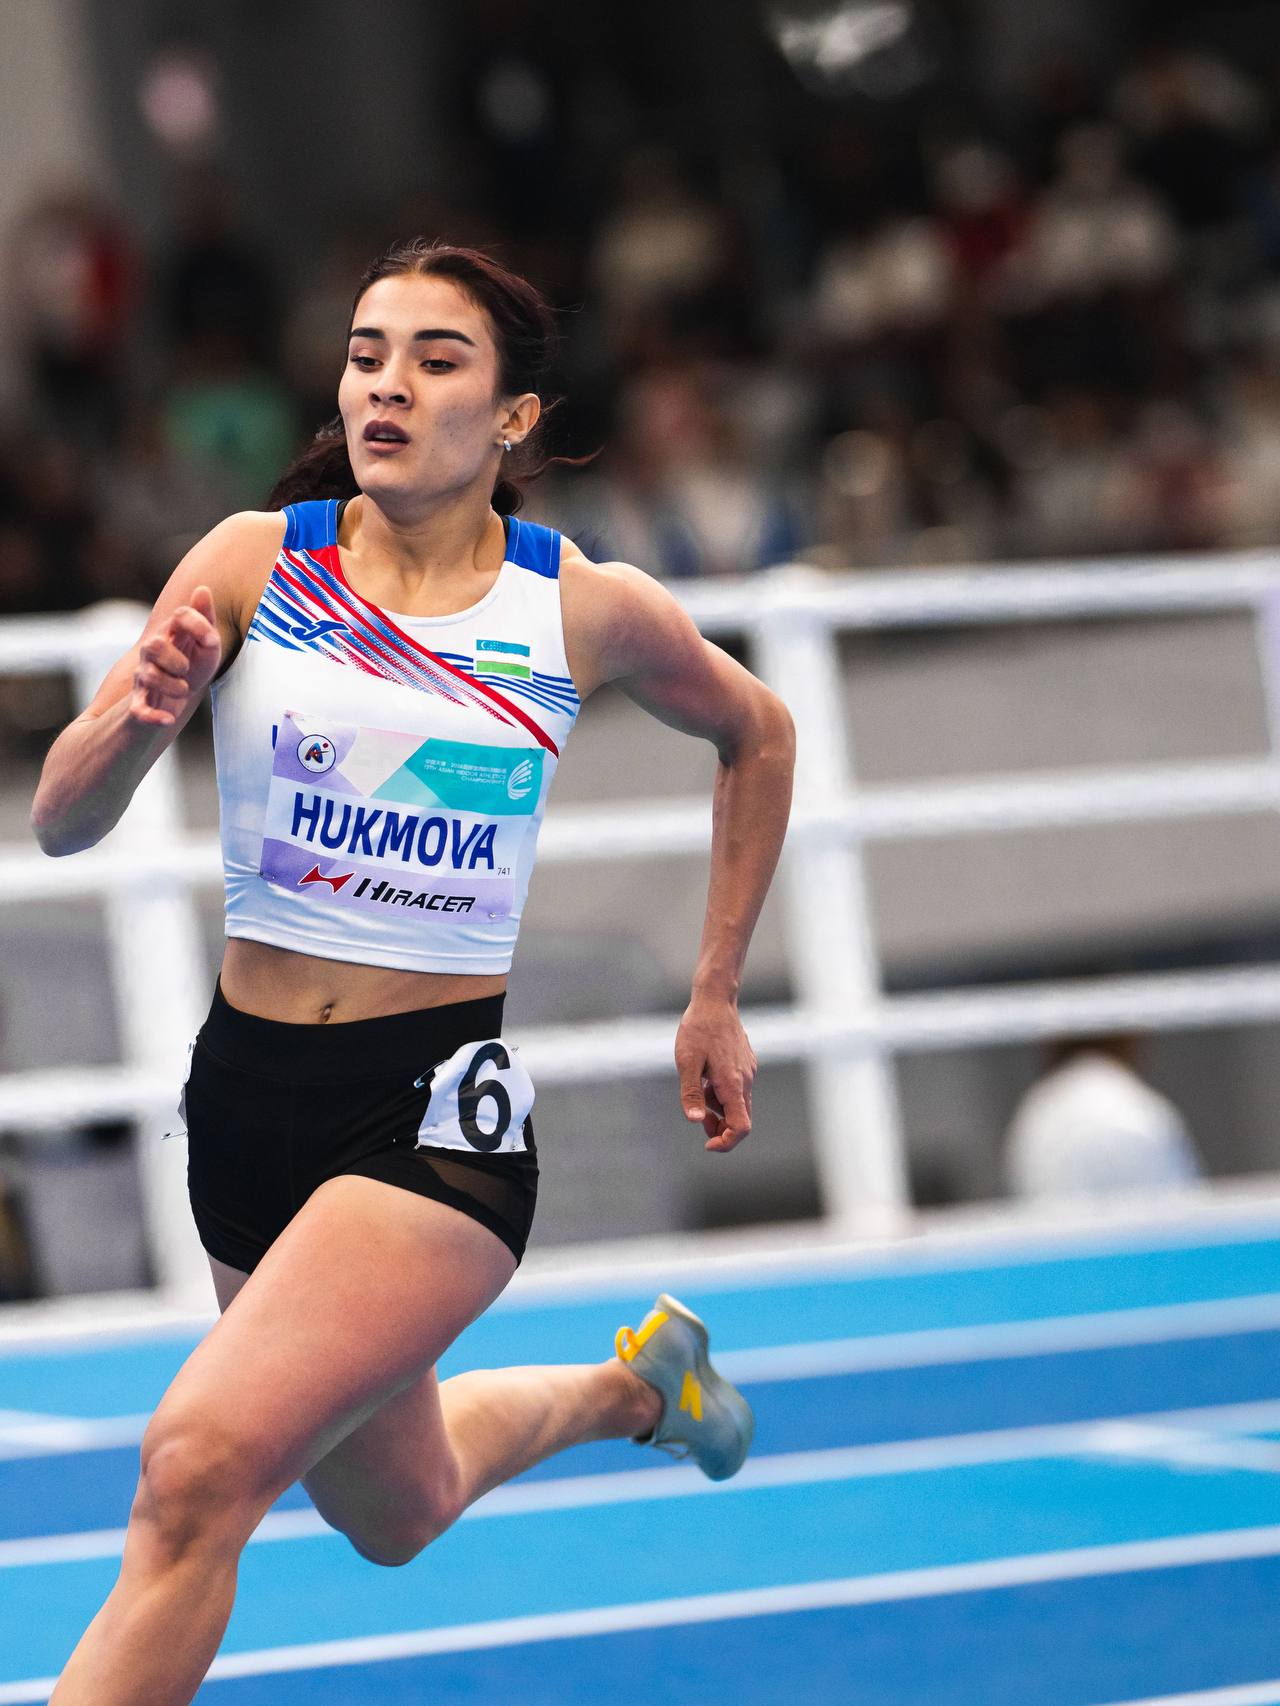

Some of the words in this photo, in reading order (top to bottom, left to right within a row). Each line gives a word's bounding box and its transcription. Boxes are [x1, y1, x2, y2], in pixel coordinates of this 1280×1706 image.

[291, 791, 498, 870] HUKMOVA
[497, 867, 511, 876] 741
[457, 1042, 512, 1152] 6
